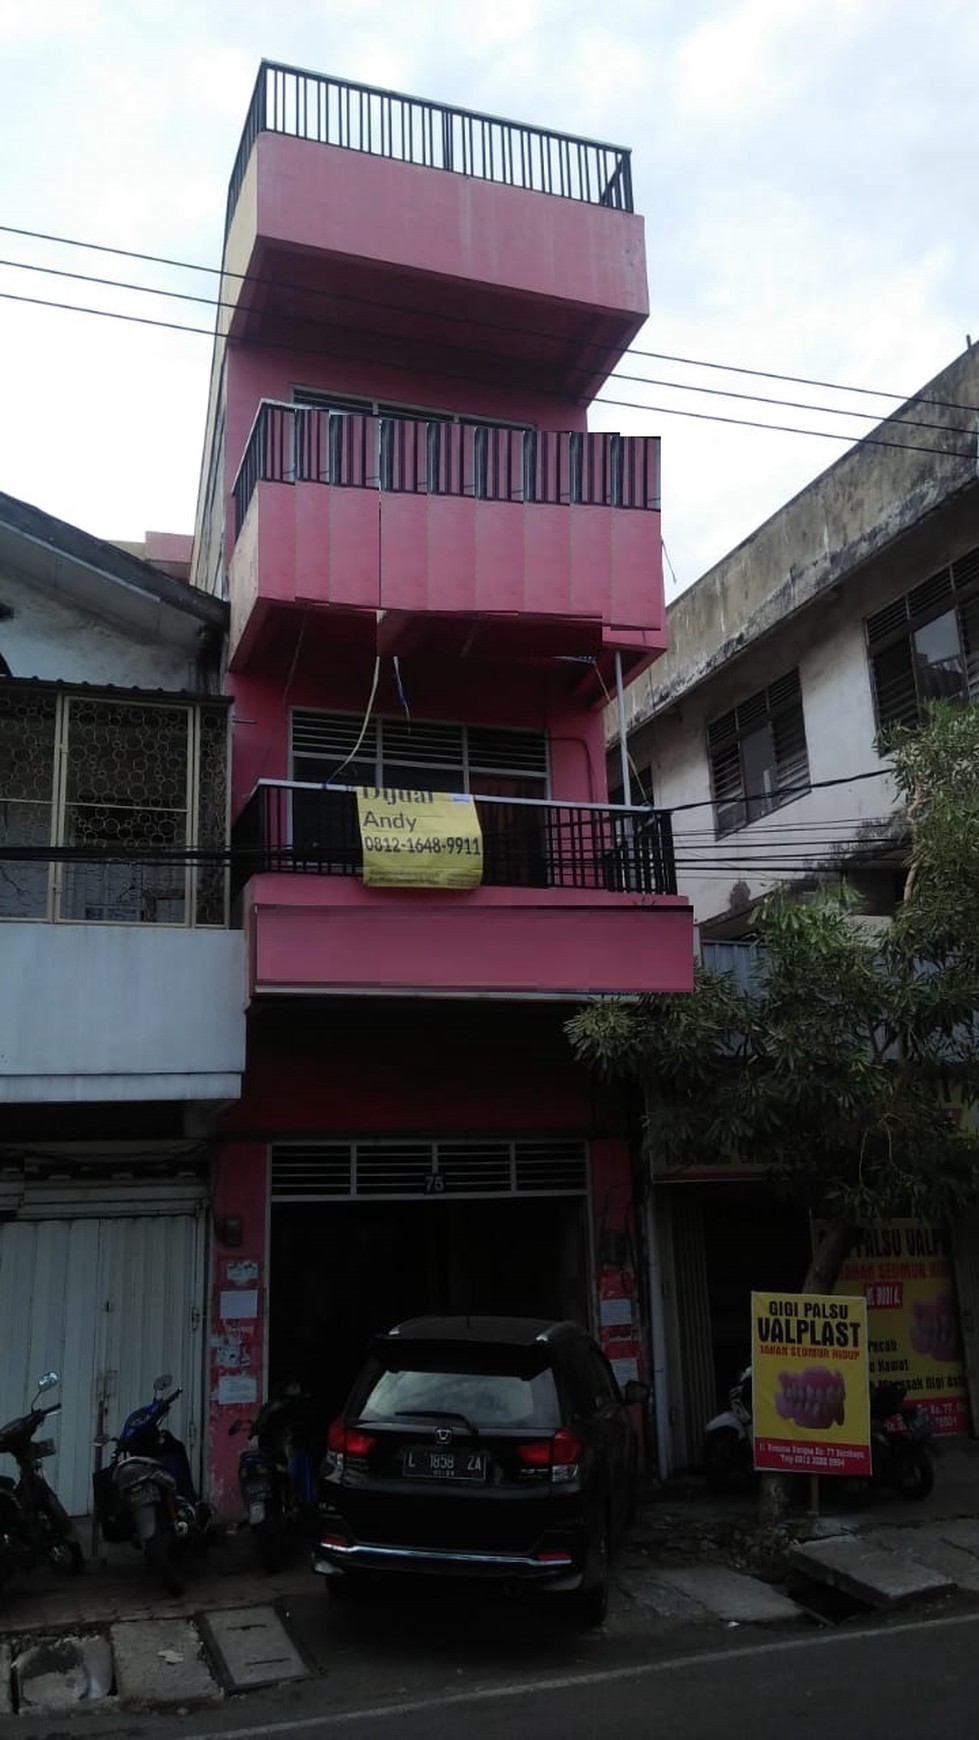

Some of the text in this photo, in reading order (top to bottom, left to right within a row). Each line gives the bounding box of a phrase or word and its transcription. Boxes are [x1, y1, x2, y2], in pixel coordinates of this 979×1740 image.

[363, 811, 417, 833] Andy
[364, 836, 481, 855] 0812-1648-9911
[425, 1175, 445, 1192] 75
[769, 1300, 848, 1320] GIGI PALSU
[757, 1317, 861, 1348] VALPLAST
[408, 1452, 416, 1468] L
[467, 1456, 482, 1471] ZA
